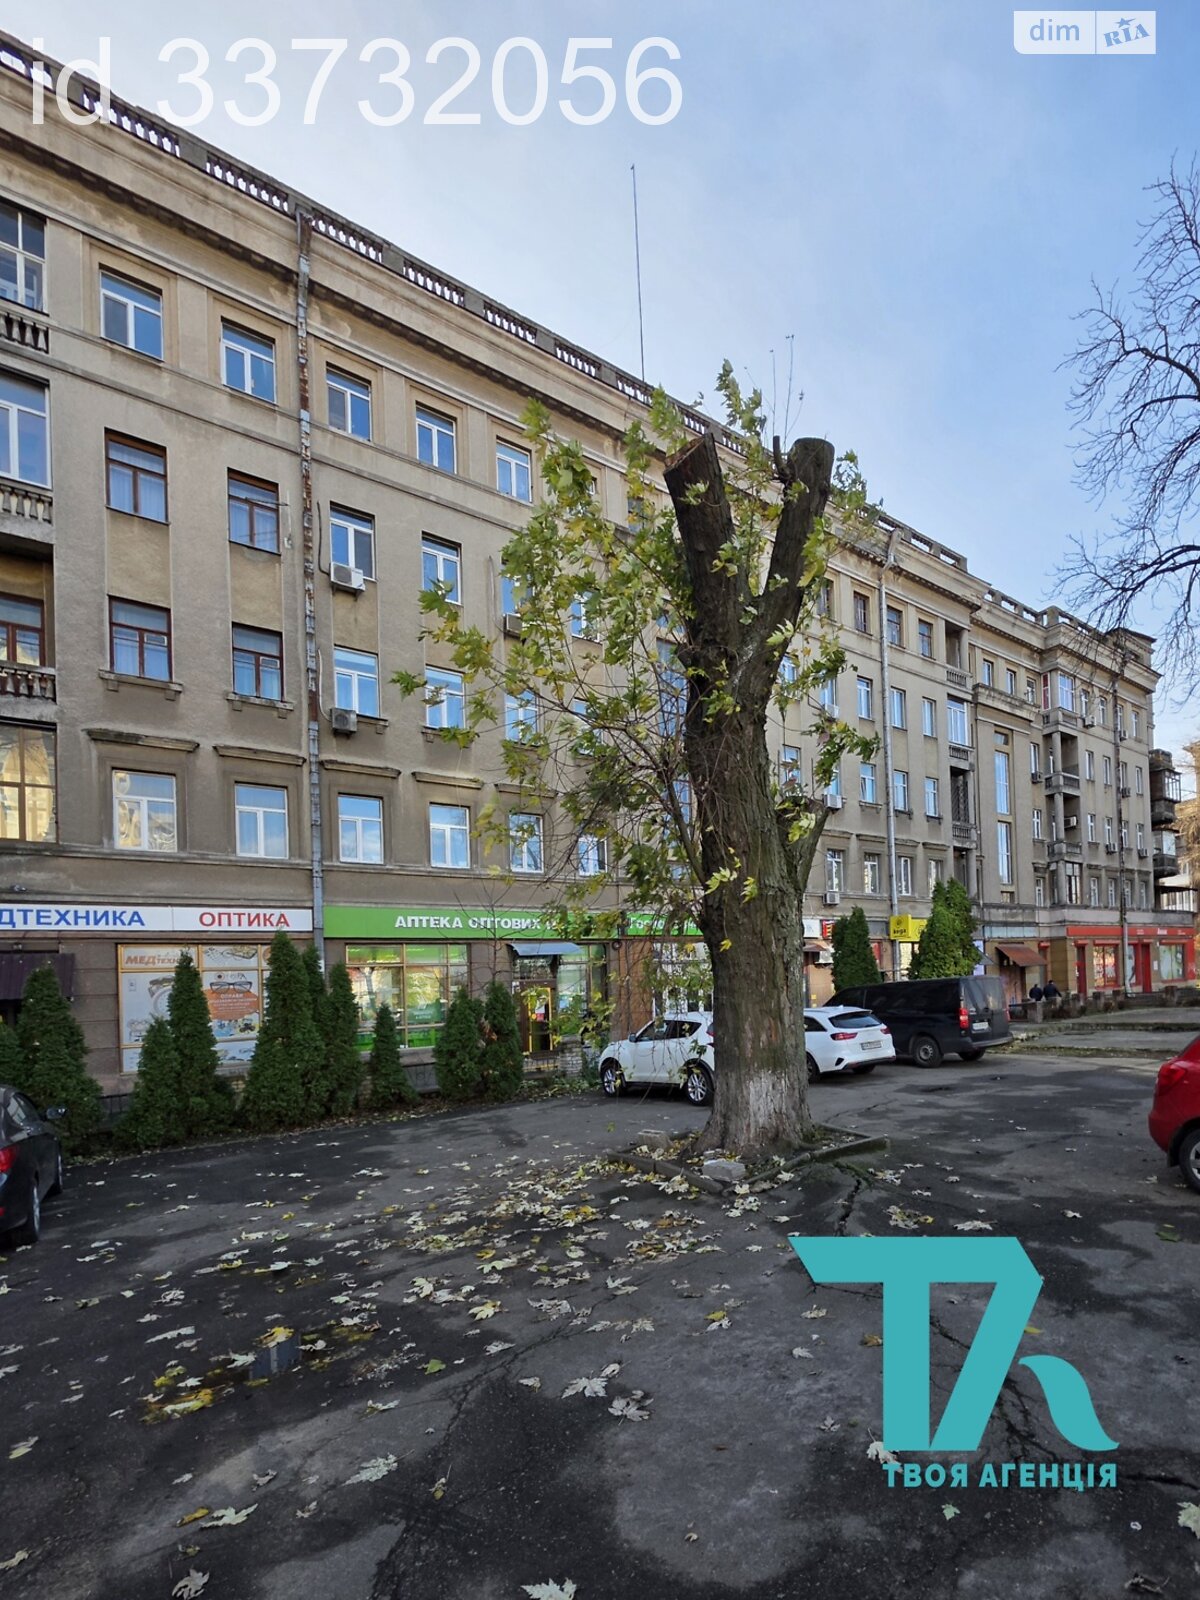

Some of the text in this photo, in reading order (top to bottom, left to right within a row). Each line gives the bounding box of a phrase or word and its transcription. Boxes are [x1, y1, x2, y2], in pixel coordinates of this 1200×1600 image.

[199, 912, 290, 927] ОПТИКА
[394, 915, 463, 928] АПТЕКА
[468, 917, 541, 929] ОПТОВИХ
